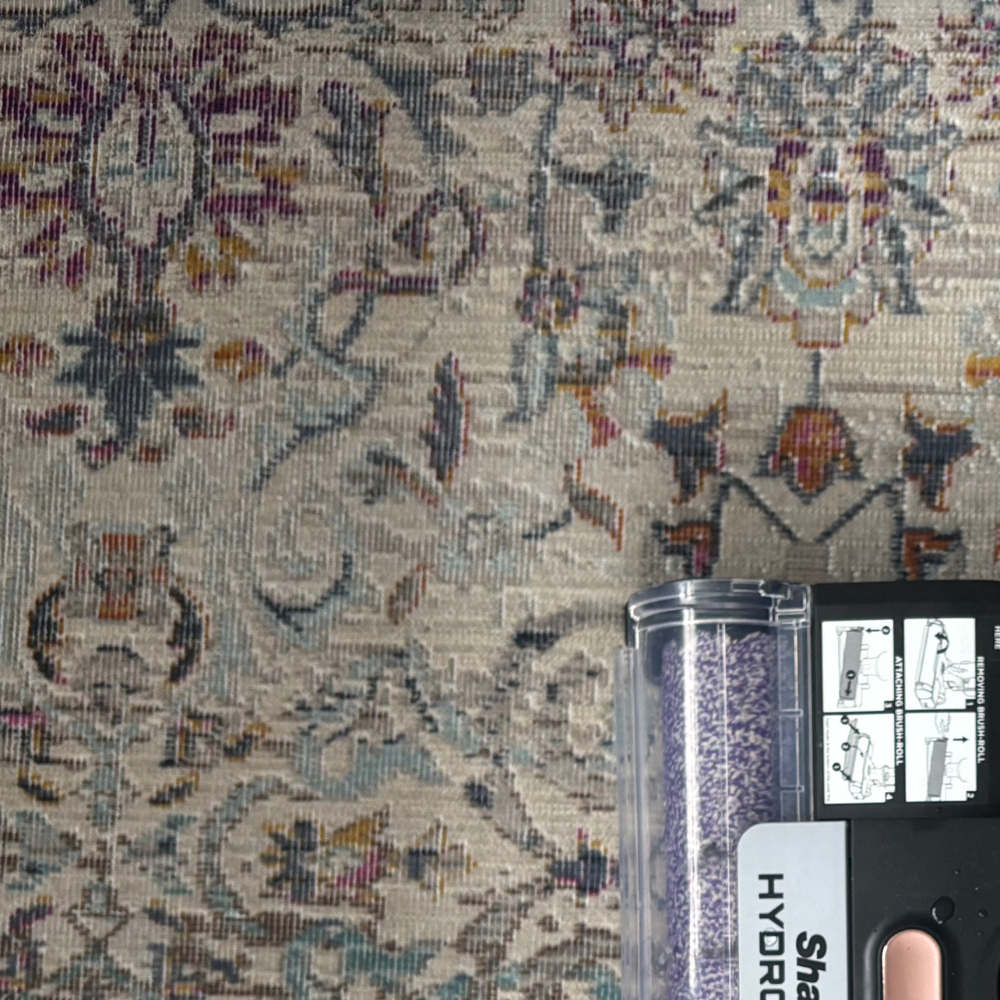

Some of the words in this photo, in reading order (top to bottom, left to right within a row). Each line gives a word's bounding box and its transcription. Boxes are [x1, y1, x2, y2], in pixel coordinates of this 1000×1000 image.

[895, 656, 904, 708] ATTACHING
[977, 656, 985, 705] REMOVING
[895, 709, 904, 766] BRUSH-ROLL
[977, 706, 986, 764] BRUSH-ROLL
